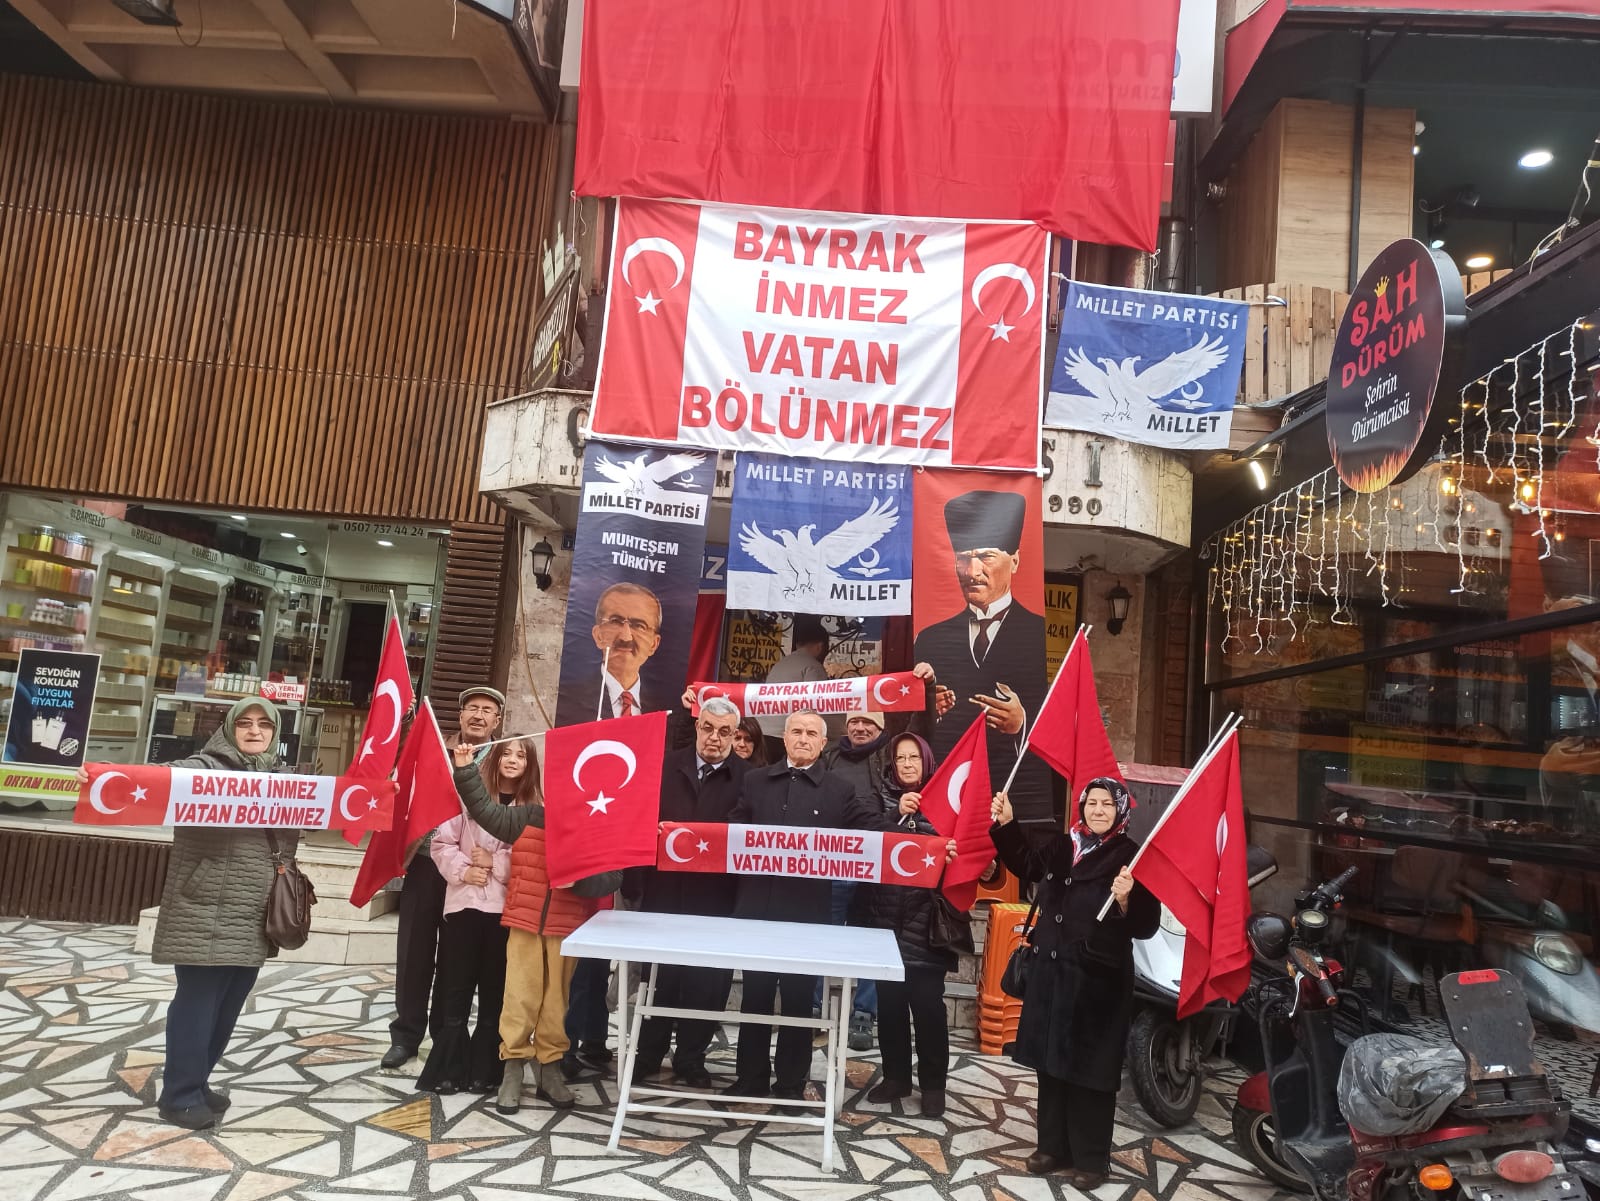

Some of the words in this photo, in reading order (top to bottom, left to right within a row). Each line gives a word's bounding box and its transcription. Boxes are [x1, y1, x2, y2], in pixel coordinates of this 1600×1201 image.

[734, 221, 928, 274] BAYRAK
[755, 270, 908, 325] İNMEZ
[742, 330, 899, 385] VATAN
[1341, 312, 1426, 390] DÜRÜM
[1364, 371, 1398, 414] Şehrin
[681, 378, 952, 450] BÖLÜNMEZ
[1351, 391, 1411, 444] Dürümcüsü
[589, 492, 642, 510] MİLLET
[644, 502, 701, 520] PARTİSİ
[344, 522, 371, 533] 0507
[373, 524, 392, 534] 737
[394, 526, 408, 535] 44
[410, 527, 424, 537] 24
[601, 531, 679, 557] MUHTEŞEM
[611, 550, 667, 574] TÜRKİYE
[33, 677, 79, 688] KOKULAR
[37, 688, 72, 698] UYGUN
[759, 685, 809, 696] BAYRAK
[813, 681, 853, 694] İNMEZ
[749, 700, 789, 715] VATAN
[791, 696, 862, 713] BÖLÜNMEZ
[3, 774, 43, 790] ORTAM
[43, 778, 81, 793] KOKUL
[192, 775, 262, 797] BAYRAK
[266, 776, 318, 800] İNMEZ
[174, 803, 233, 823] VATAN
[234, 802, 325, 826] BÖLÜNMEZ
[745, 830, 808, 851] BAYRAK
[813, 830, 864, 855] İNMEZ
[733, 853, 783, 873] VATAN
[786, 855, 875, 880] BÖLÜNMEZ
